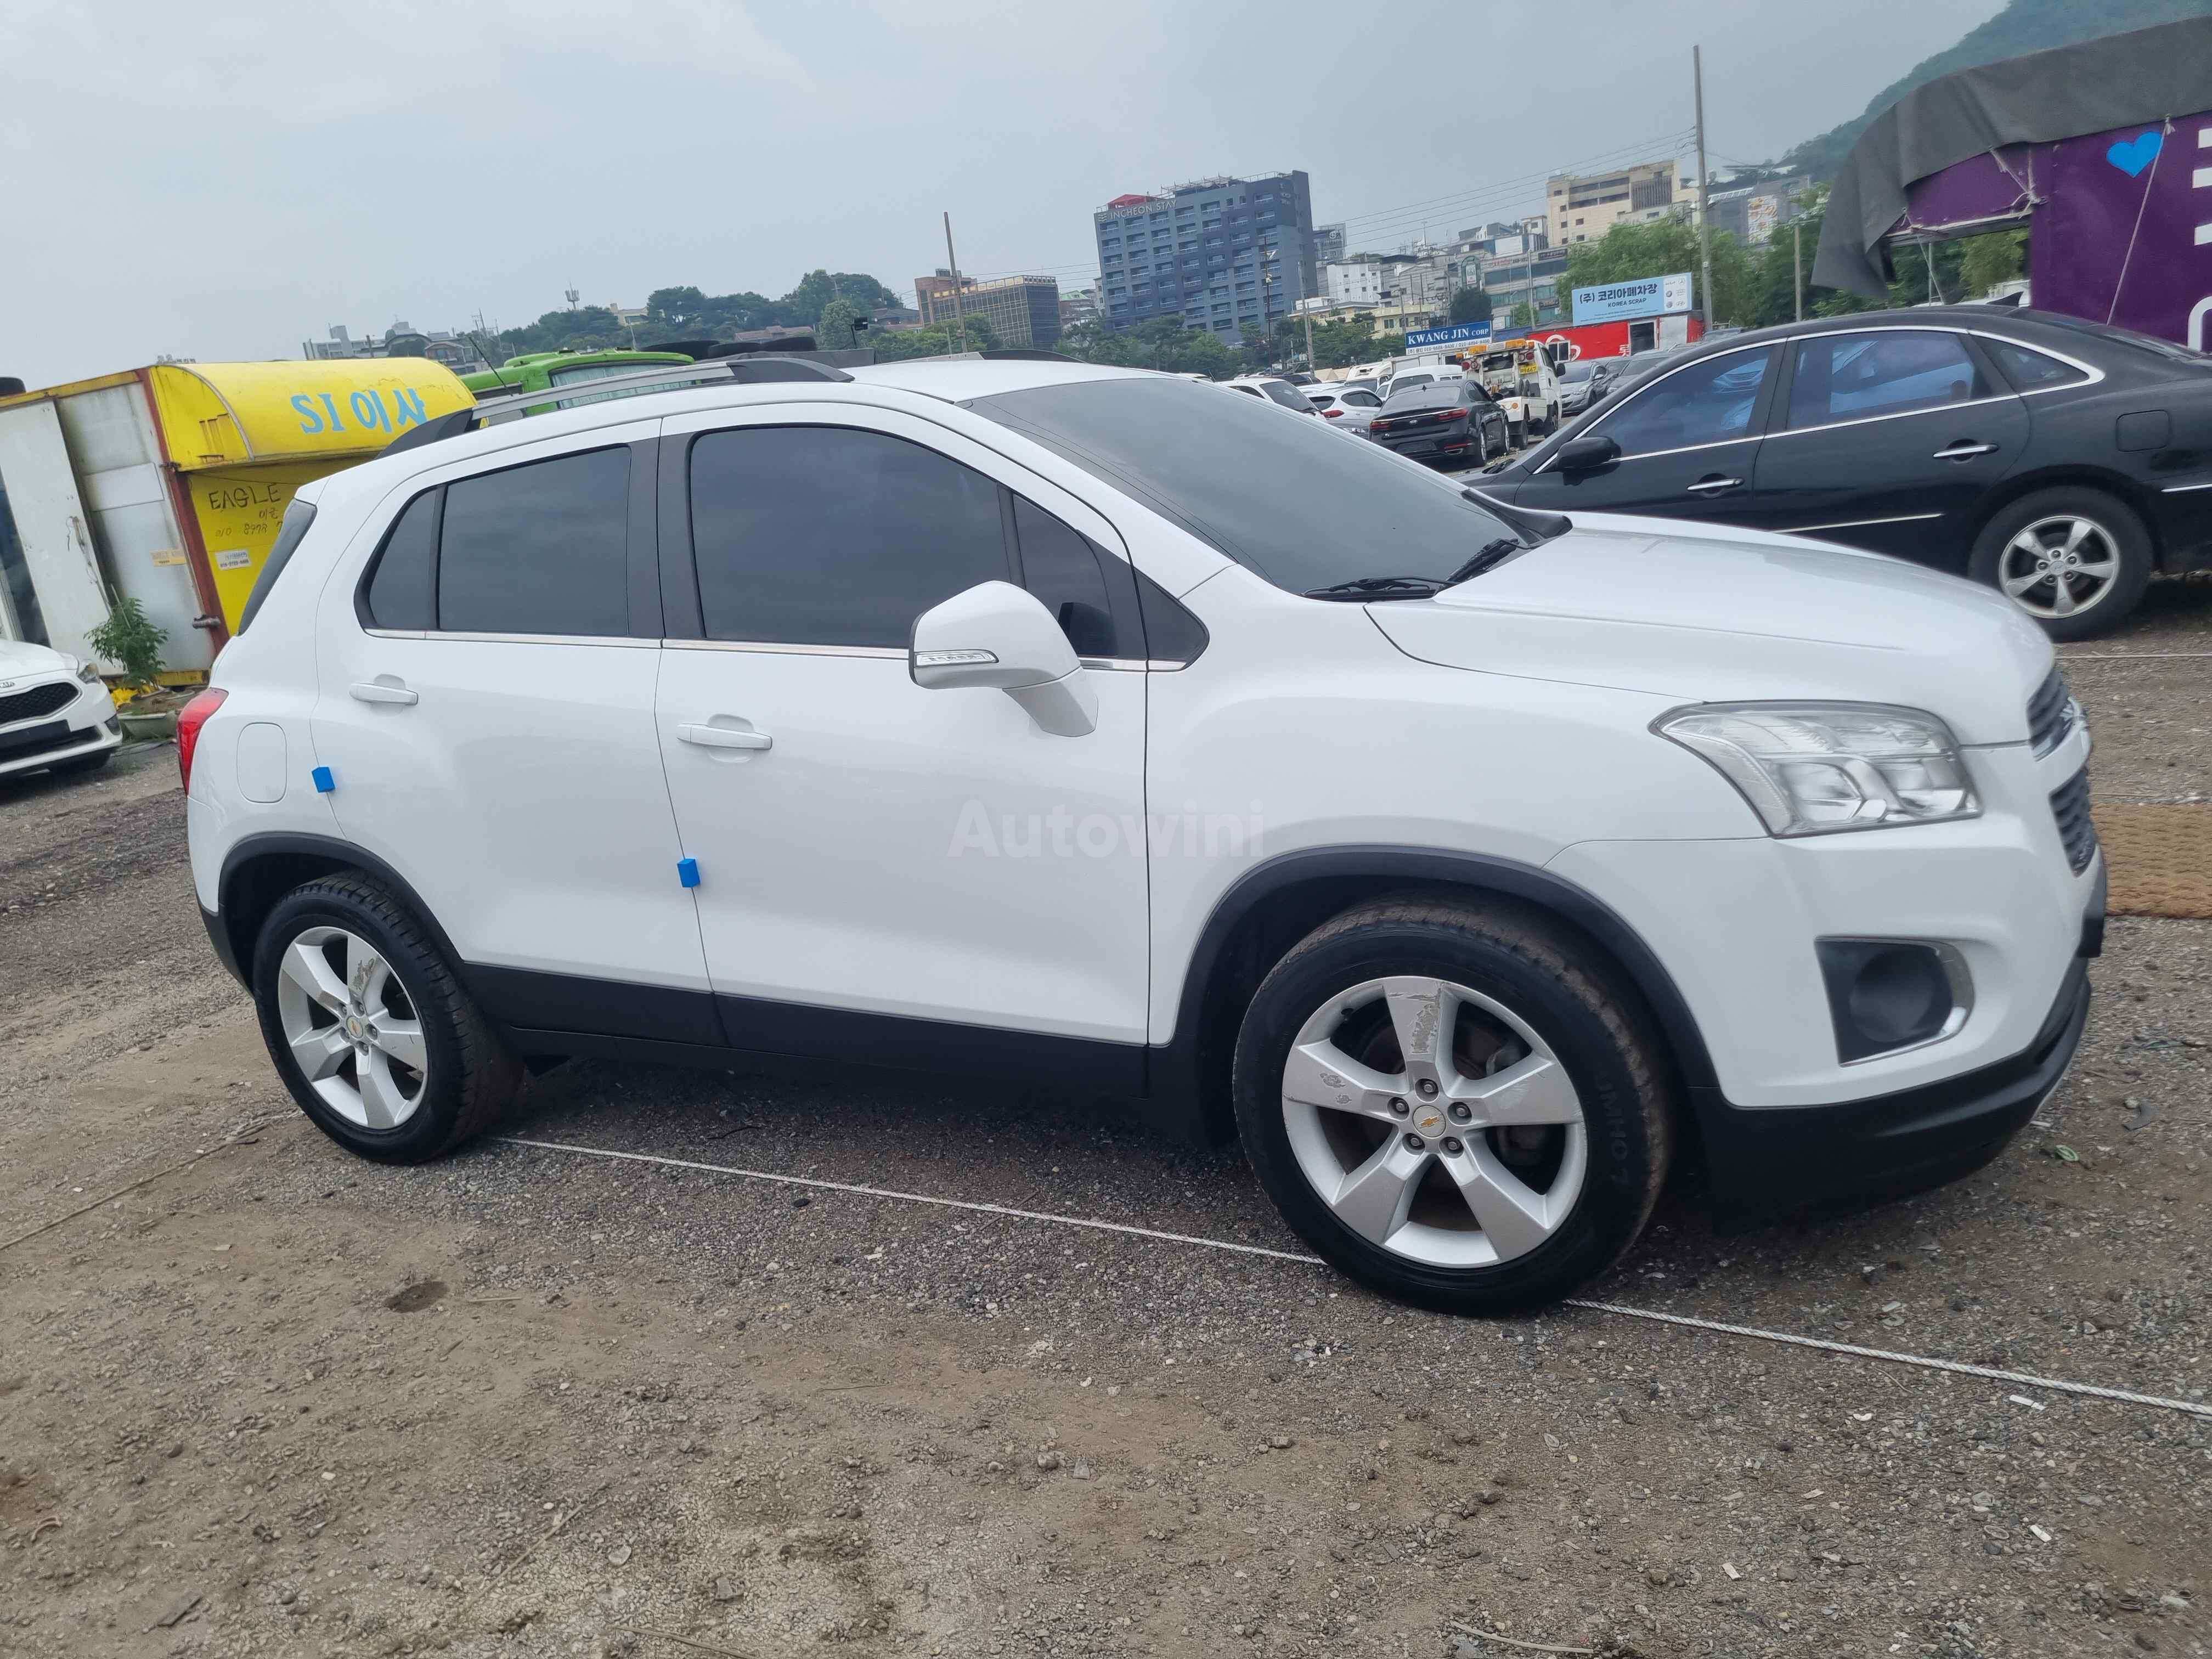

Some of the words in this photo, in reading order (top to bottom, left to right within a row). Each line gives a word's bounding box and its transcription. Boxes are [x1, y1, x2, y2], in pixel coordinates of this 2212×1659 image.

[1110, 205, 1153, 219] INCHEON
[1156, 200, 1177, 211] STAY
[1579, 292, 1595, 304] (주)
[1408, 330, 1449, 345] KWANG
[1451, 328, 1469, 339] JIN
[1471, 328, 1489, 336] CORP
[290, 392, 347, 435] SI
[349, 387, 429, 433] 이사
[208, 483, 281, 510] EAGLE
